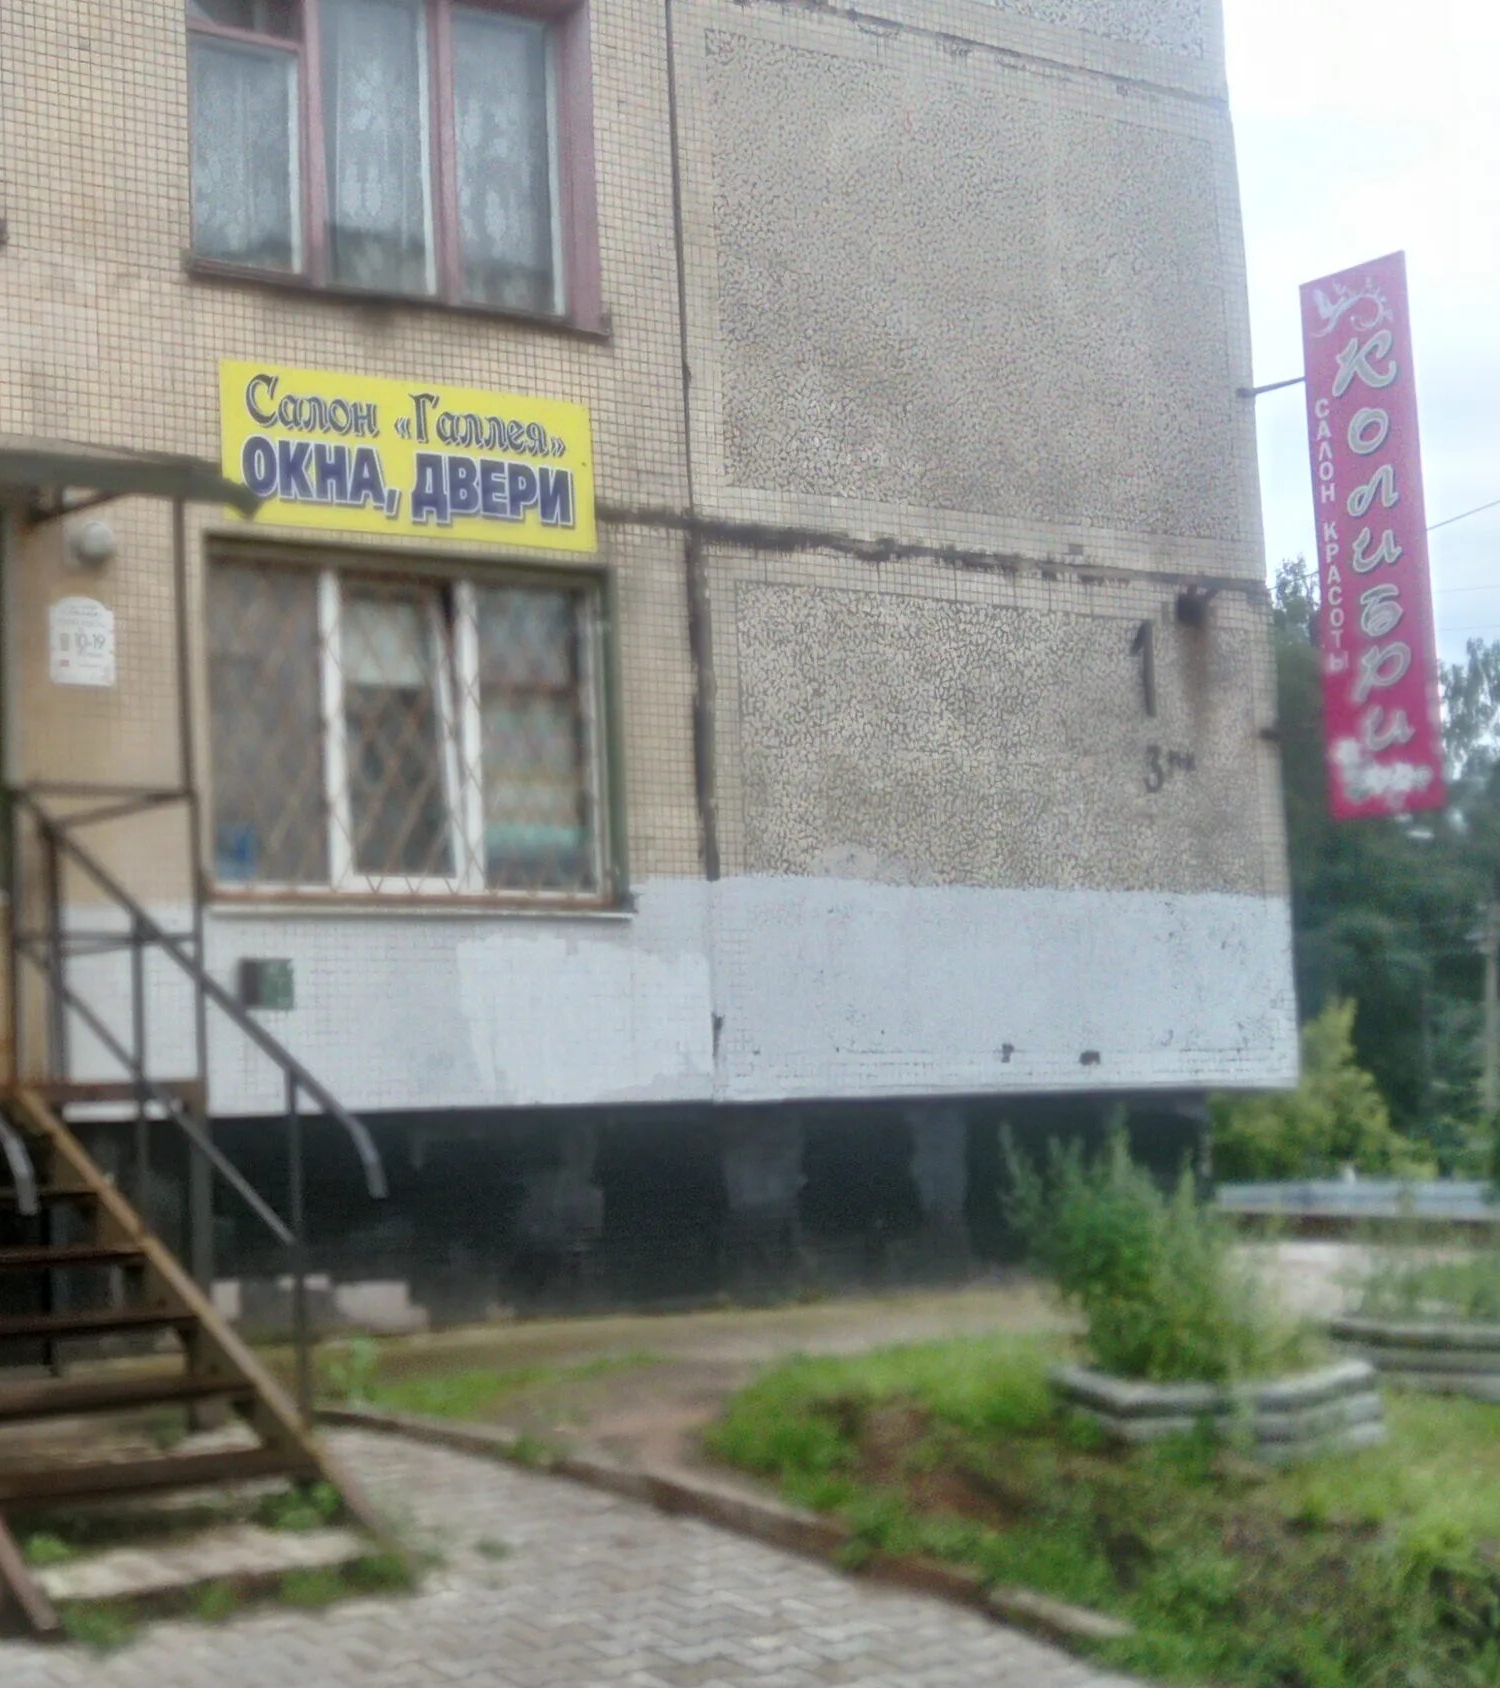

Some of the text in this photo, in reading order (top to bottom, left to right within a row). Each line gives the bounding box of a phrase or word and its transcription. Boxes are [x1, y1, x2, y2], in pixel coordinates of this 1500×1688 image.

[242, 436, 576, 528] ОКНА, ДВЕРИ
[245, 374, 566, 457] Салон «Галлея»
[1315, 398, 1349, 672] САЛОН КРАСОТЫ
[1332, 329, 1415, 750] Колибри
